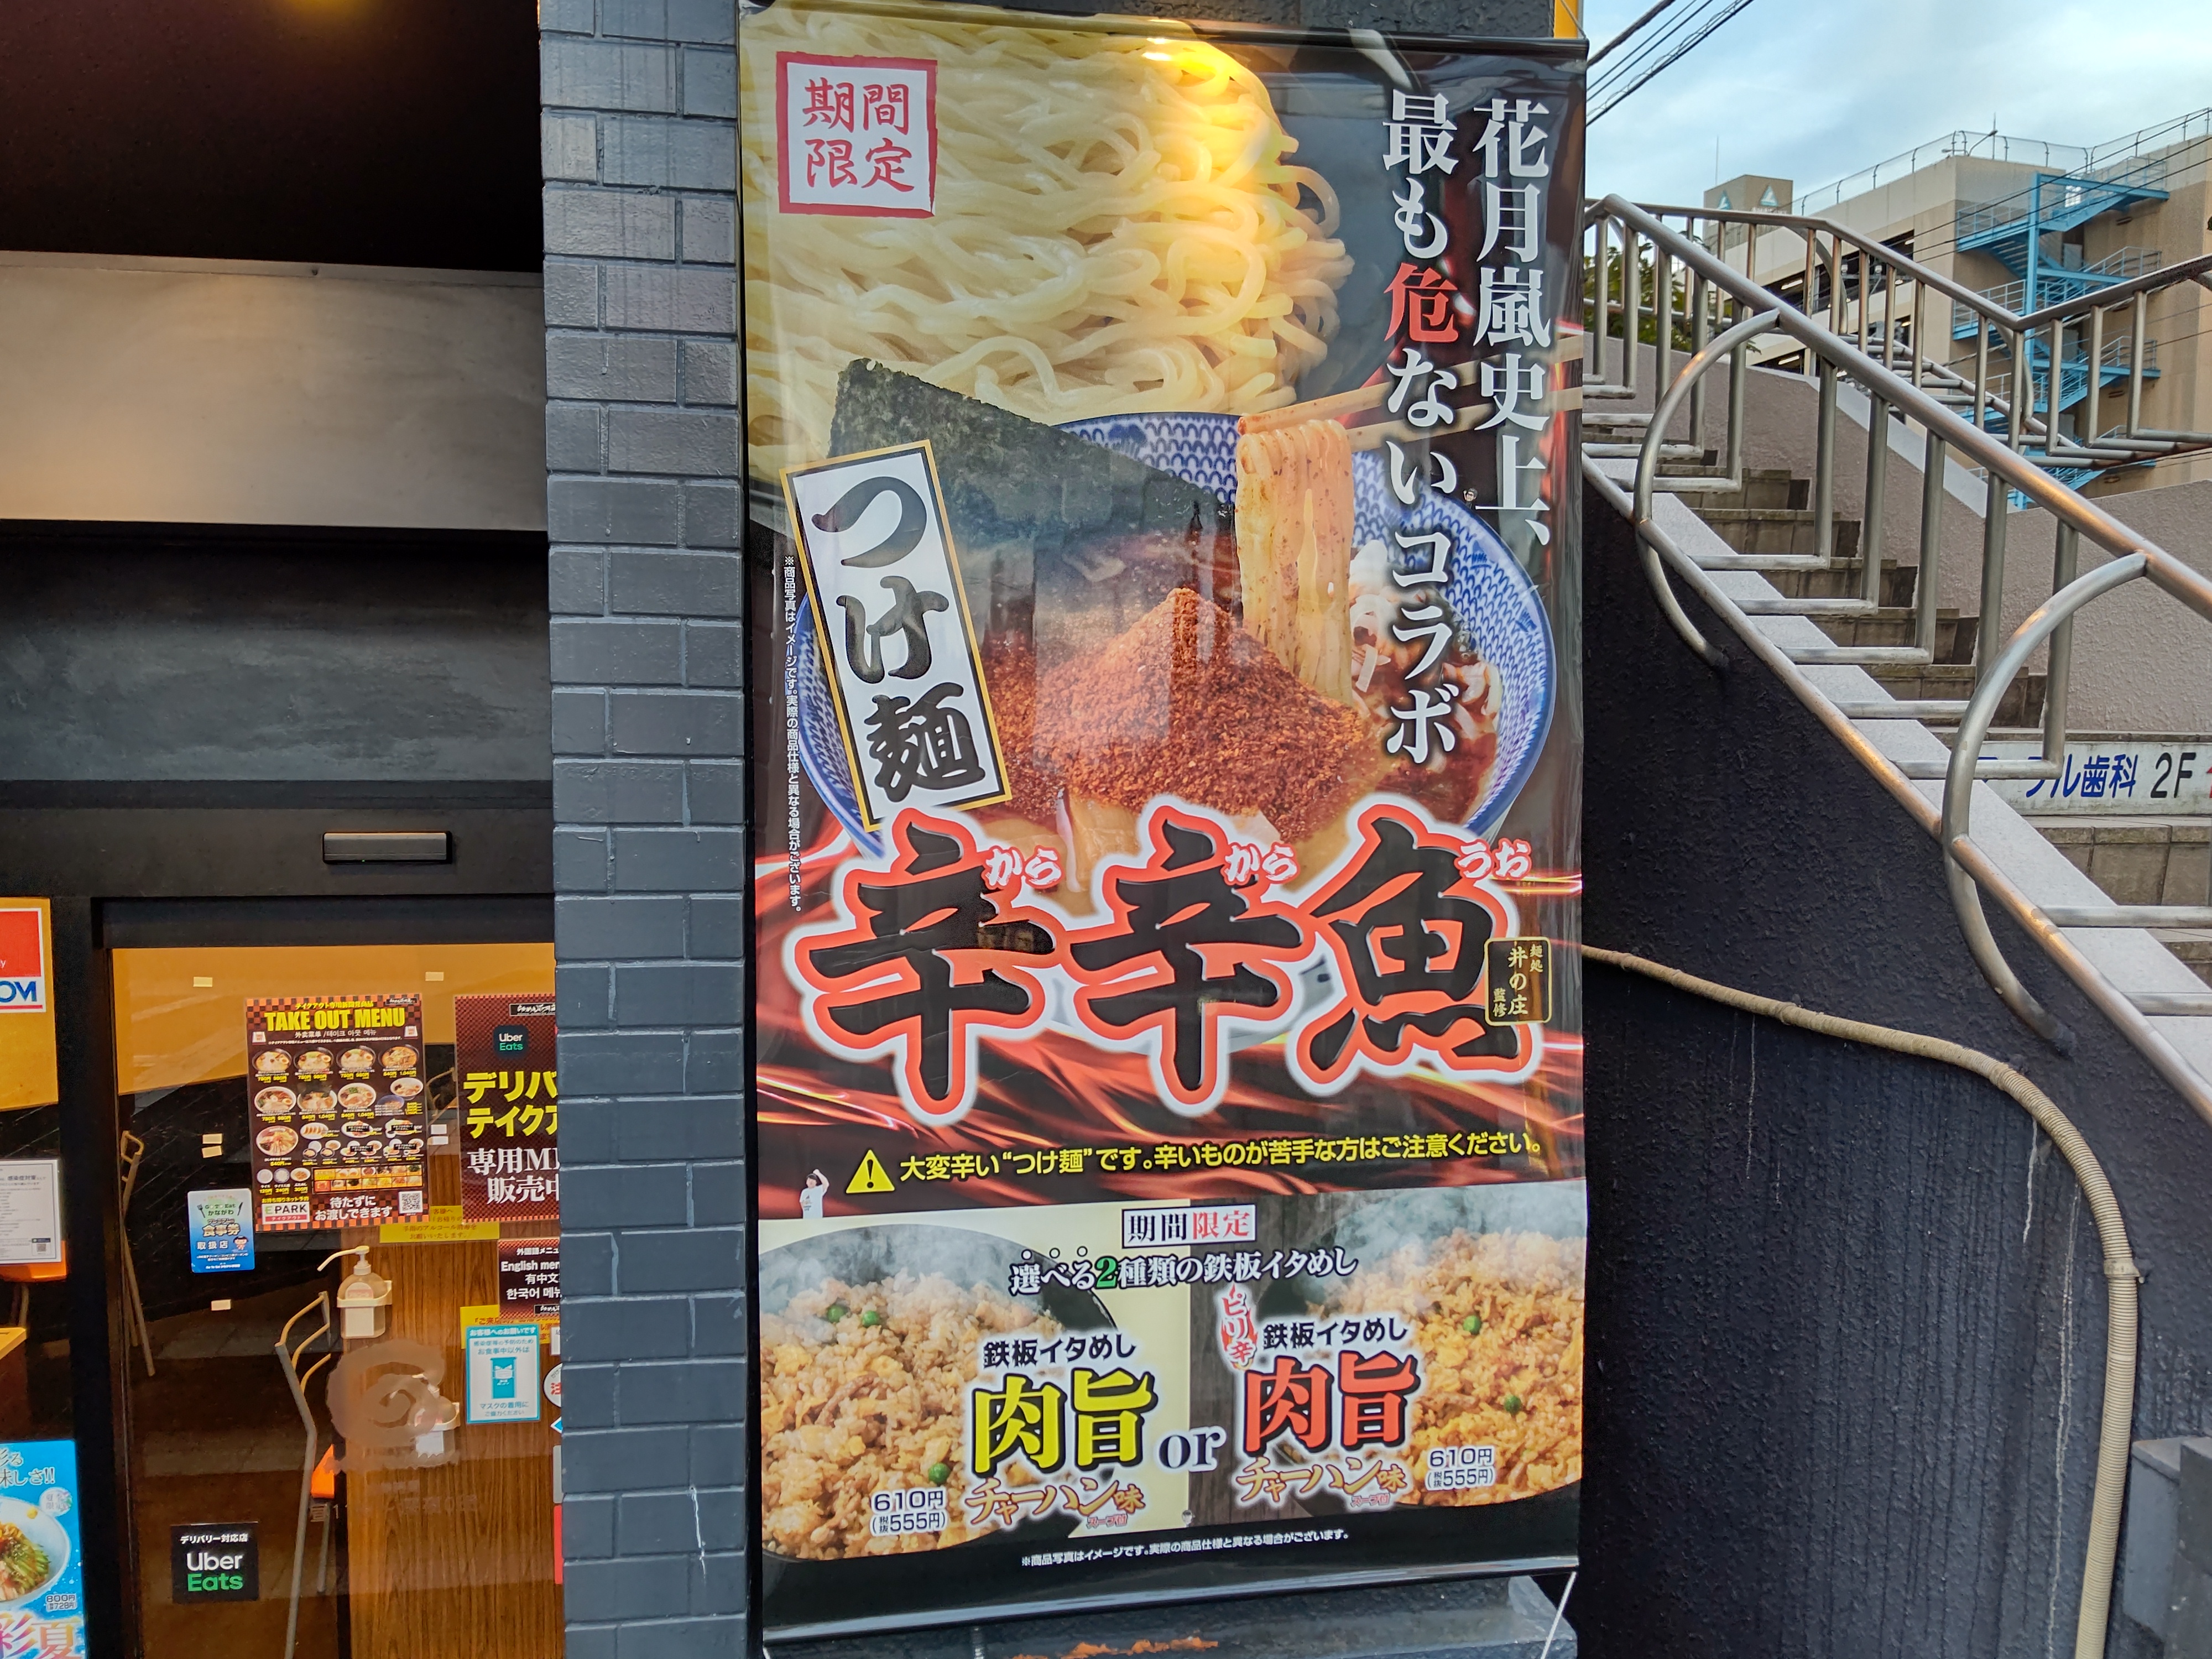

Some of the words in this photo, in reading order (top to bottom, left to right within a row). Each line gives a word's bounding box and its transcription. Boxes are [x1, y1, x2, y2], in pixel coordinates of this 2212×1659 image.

[802, 77, 909, 135] 期間
[804, 138, 914, 192] 限定
[1473, 98, 1550, 546] 花月嵐史上、
[1383, 89, 1459, 764] 最も危ないコラボ
[2150, 752, 2197, 798] 2F
[984, 847, 1061, 888] から
[1224, 843, 1298, 884] から
[1458, 839, 1531, 879] うお
[795, 805, 1532, 1114] 辛辛魚
[1507, 946, 1528, 1015] 井の庄
[264, 1011, 310, 1031] TAKE
[314, 1010, 351, 1030] OUT
[354, 1008, 405, 1027] MENU
[499, 1033, 523, 1042] Uber
[499, 1042, 523, 1051] Eats
[314, 1206, 393, 1221] お渡しできます
[330, 1195, 376, 1209] 待たずに
[1128, 1209, 1250, 1243] 期間限定
[197, 1240, 228, 1250] 取扱店
[501, 1260, 538, 1272] English
[525, 1272, 560, 1285] 有中文
[507, 1287, 540, 1300] 한국어
[1262, 1317, 1407, 1349] 鉄板イタめし
[983, 1334, 1136, 1369] 鉄板イタめし
[1243, 1350, 1420, 1457] 肉旨
[972, 1368, 1159, 1475] 肉旨
[1160, 1428, 1222, 1470] or
[1430, 1448, 1493, 1468] 610円
[1237, 1458, 1406, 1503] チャーハン味
[874, 1490, 943, 1512] 610円
[965, 1478, 1146, 1525] チャーハン味
[180, 1533, 248, 1545] デリバリー対応店
[186, 1552, 244, 1571] Uber
[46, 1594, 75, 1603] 800円
[187, 1573, 243, 1592] Eats
